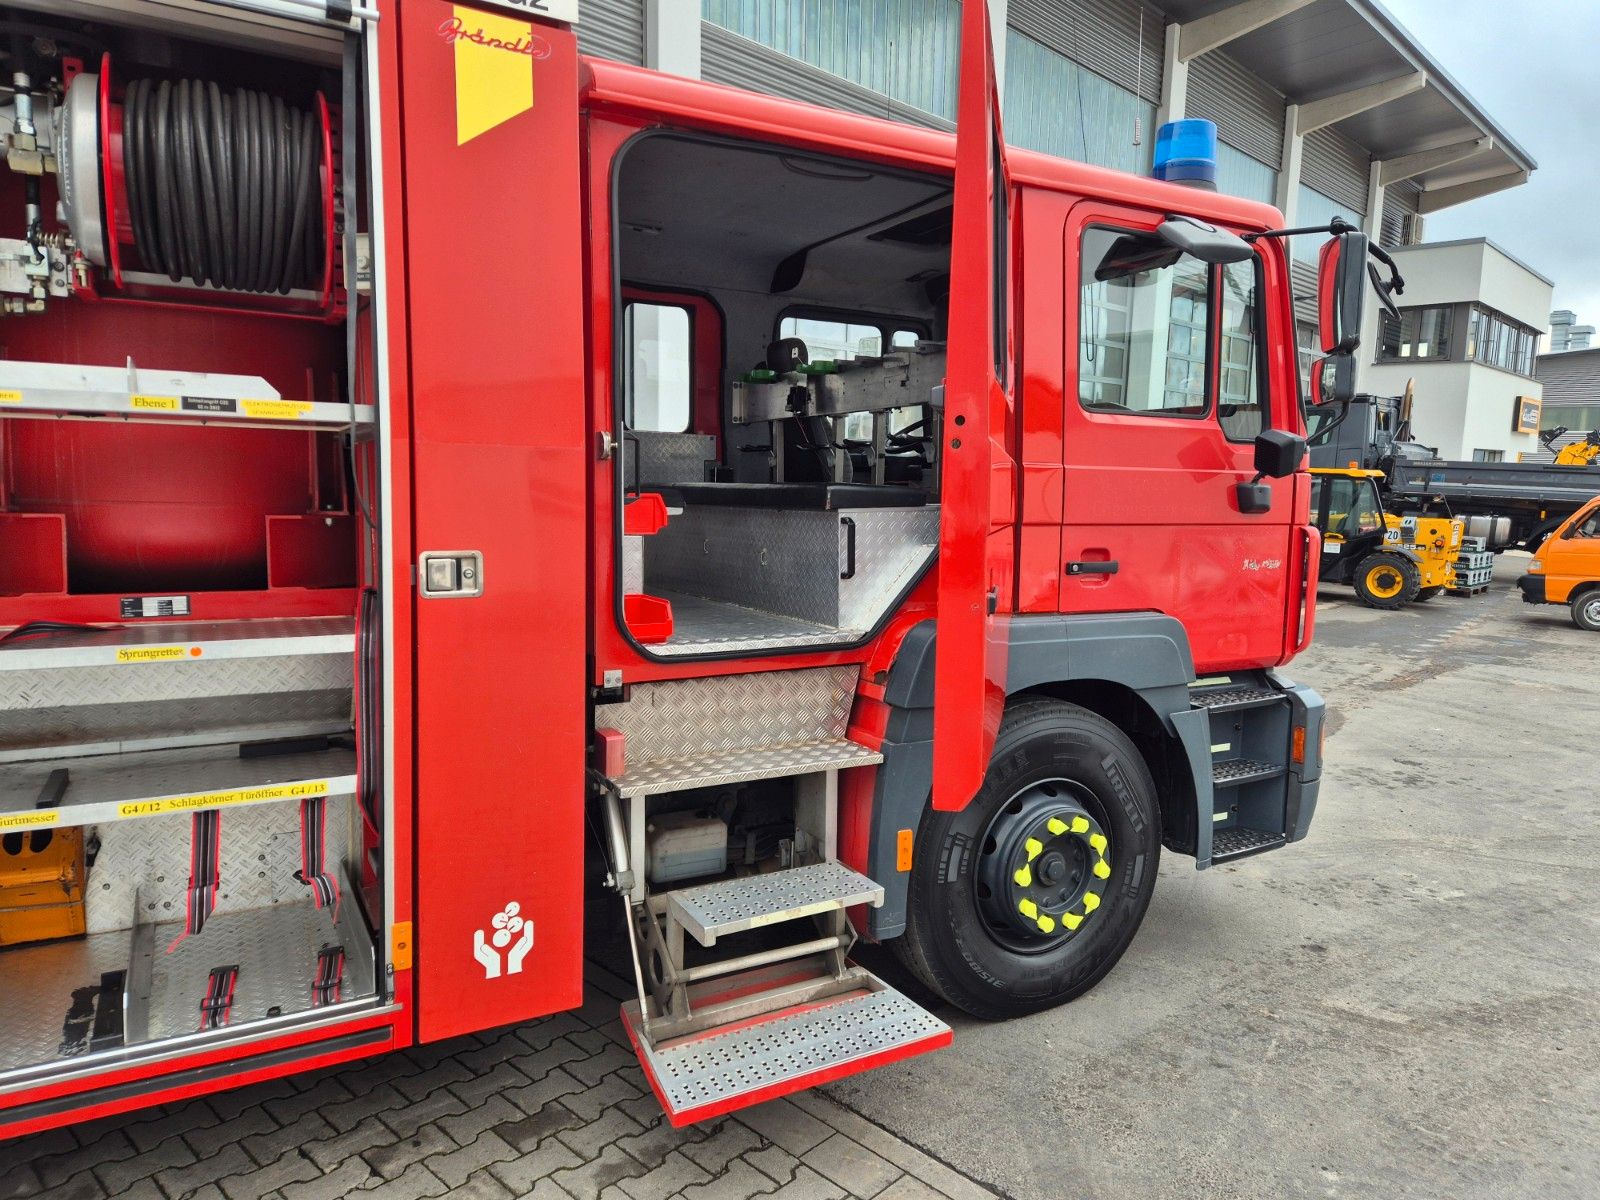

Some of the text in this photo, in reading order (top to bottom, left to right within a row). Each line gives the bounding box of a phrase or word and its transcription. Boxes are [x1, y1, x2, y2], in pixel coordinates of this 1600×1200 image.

[134, 397, 166, 407] Ebene
[1387, 530, 1398, 540] 20
[119, 648, 184, 660] Sprungretter
[122, 805, 138, 815] G4
[149, 802, 160, 812] 12
[169, 794, 233, 809] Schlagkörner
[240, 789, 283, 800] Türöffner
[291, 786, 304, 795] G4
[314, 783, 325, 792] 13
[1101, 753, 1147, 833] PIRELLI
